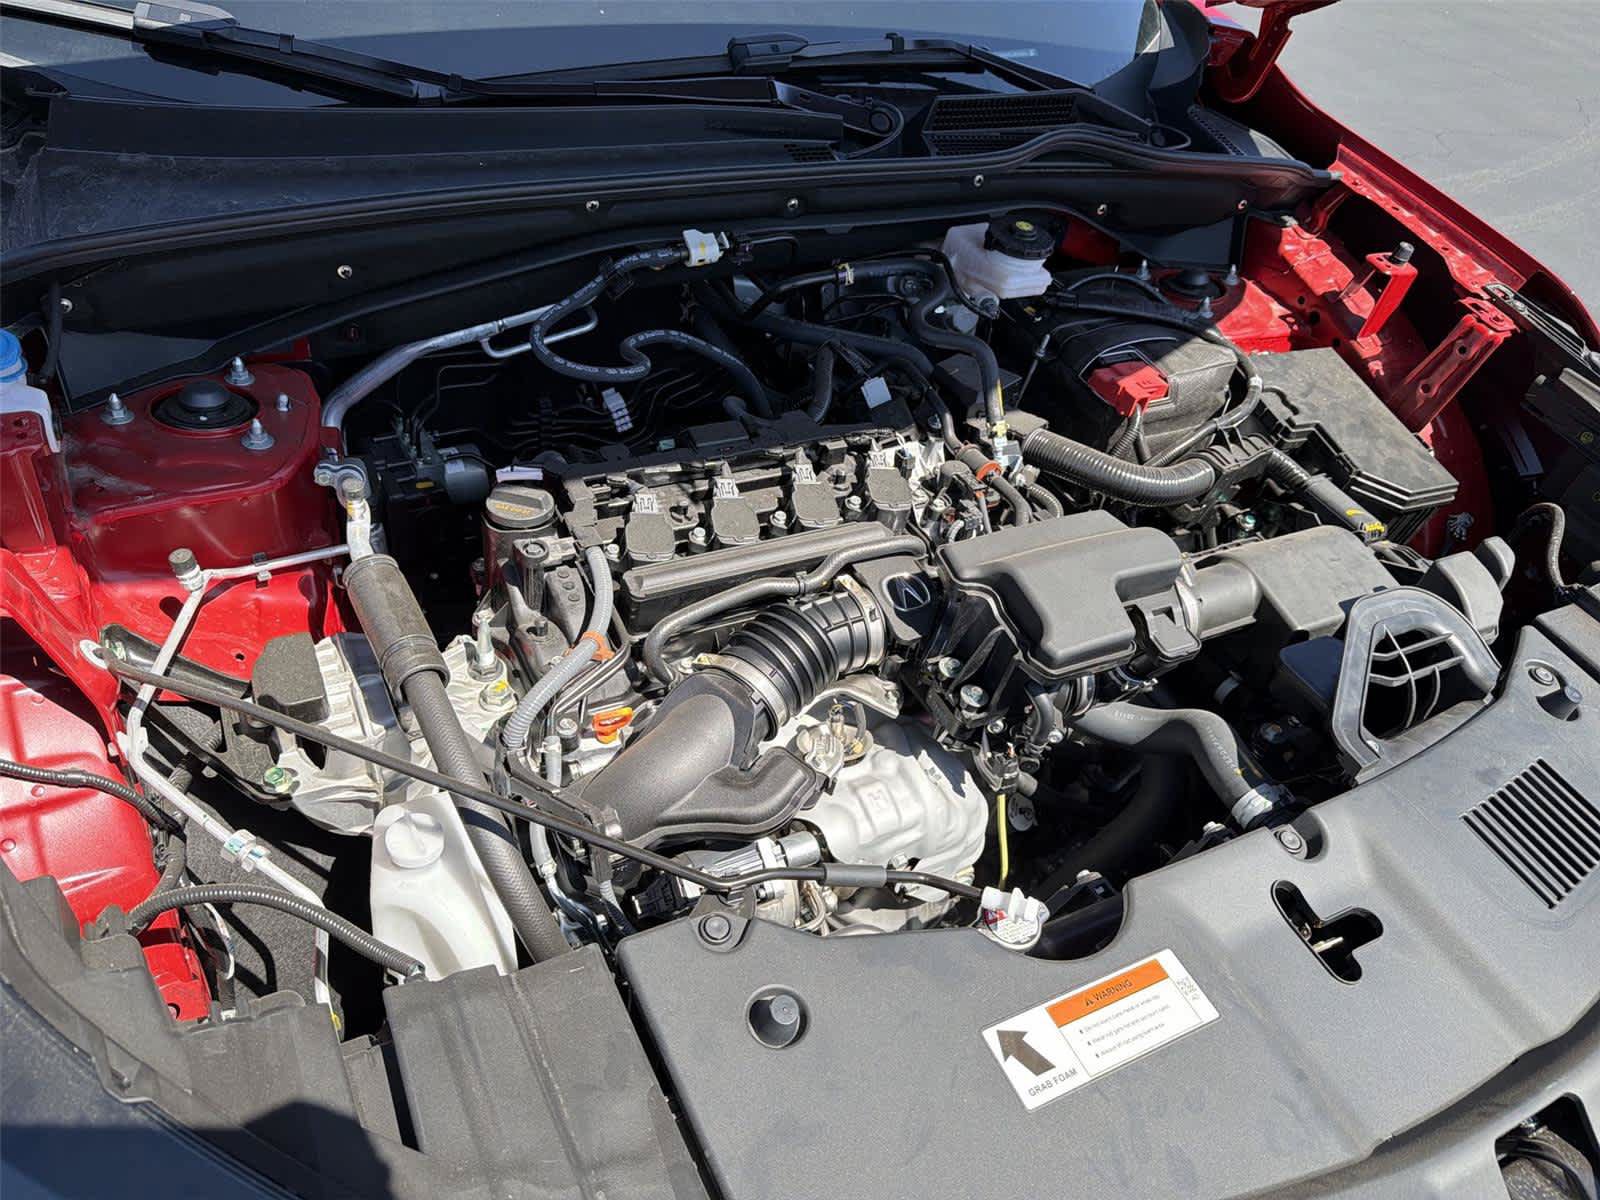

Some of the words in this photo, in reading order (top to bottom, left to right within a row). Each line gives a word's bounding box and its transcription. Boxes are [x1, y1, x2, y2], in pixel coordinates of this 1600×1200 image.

[1093, 979, 1133, 1000] WARNING
[1028, 1079, 1053, 1097] GRAB
[1053, 1068, 1077, 1086] FOAM
